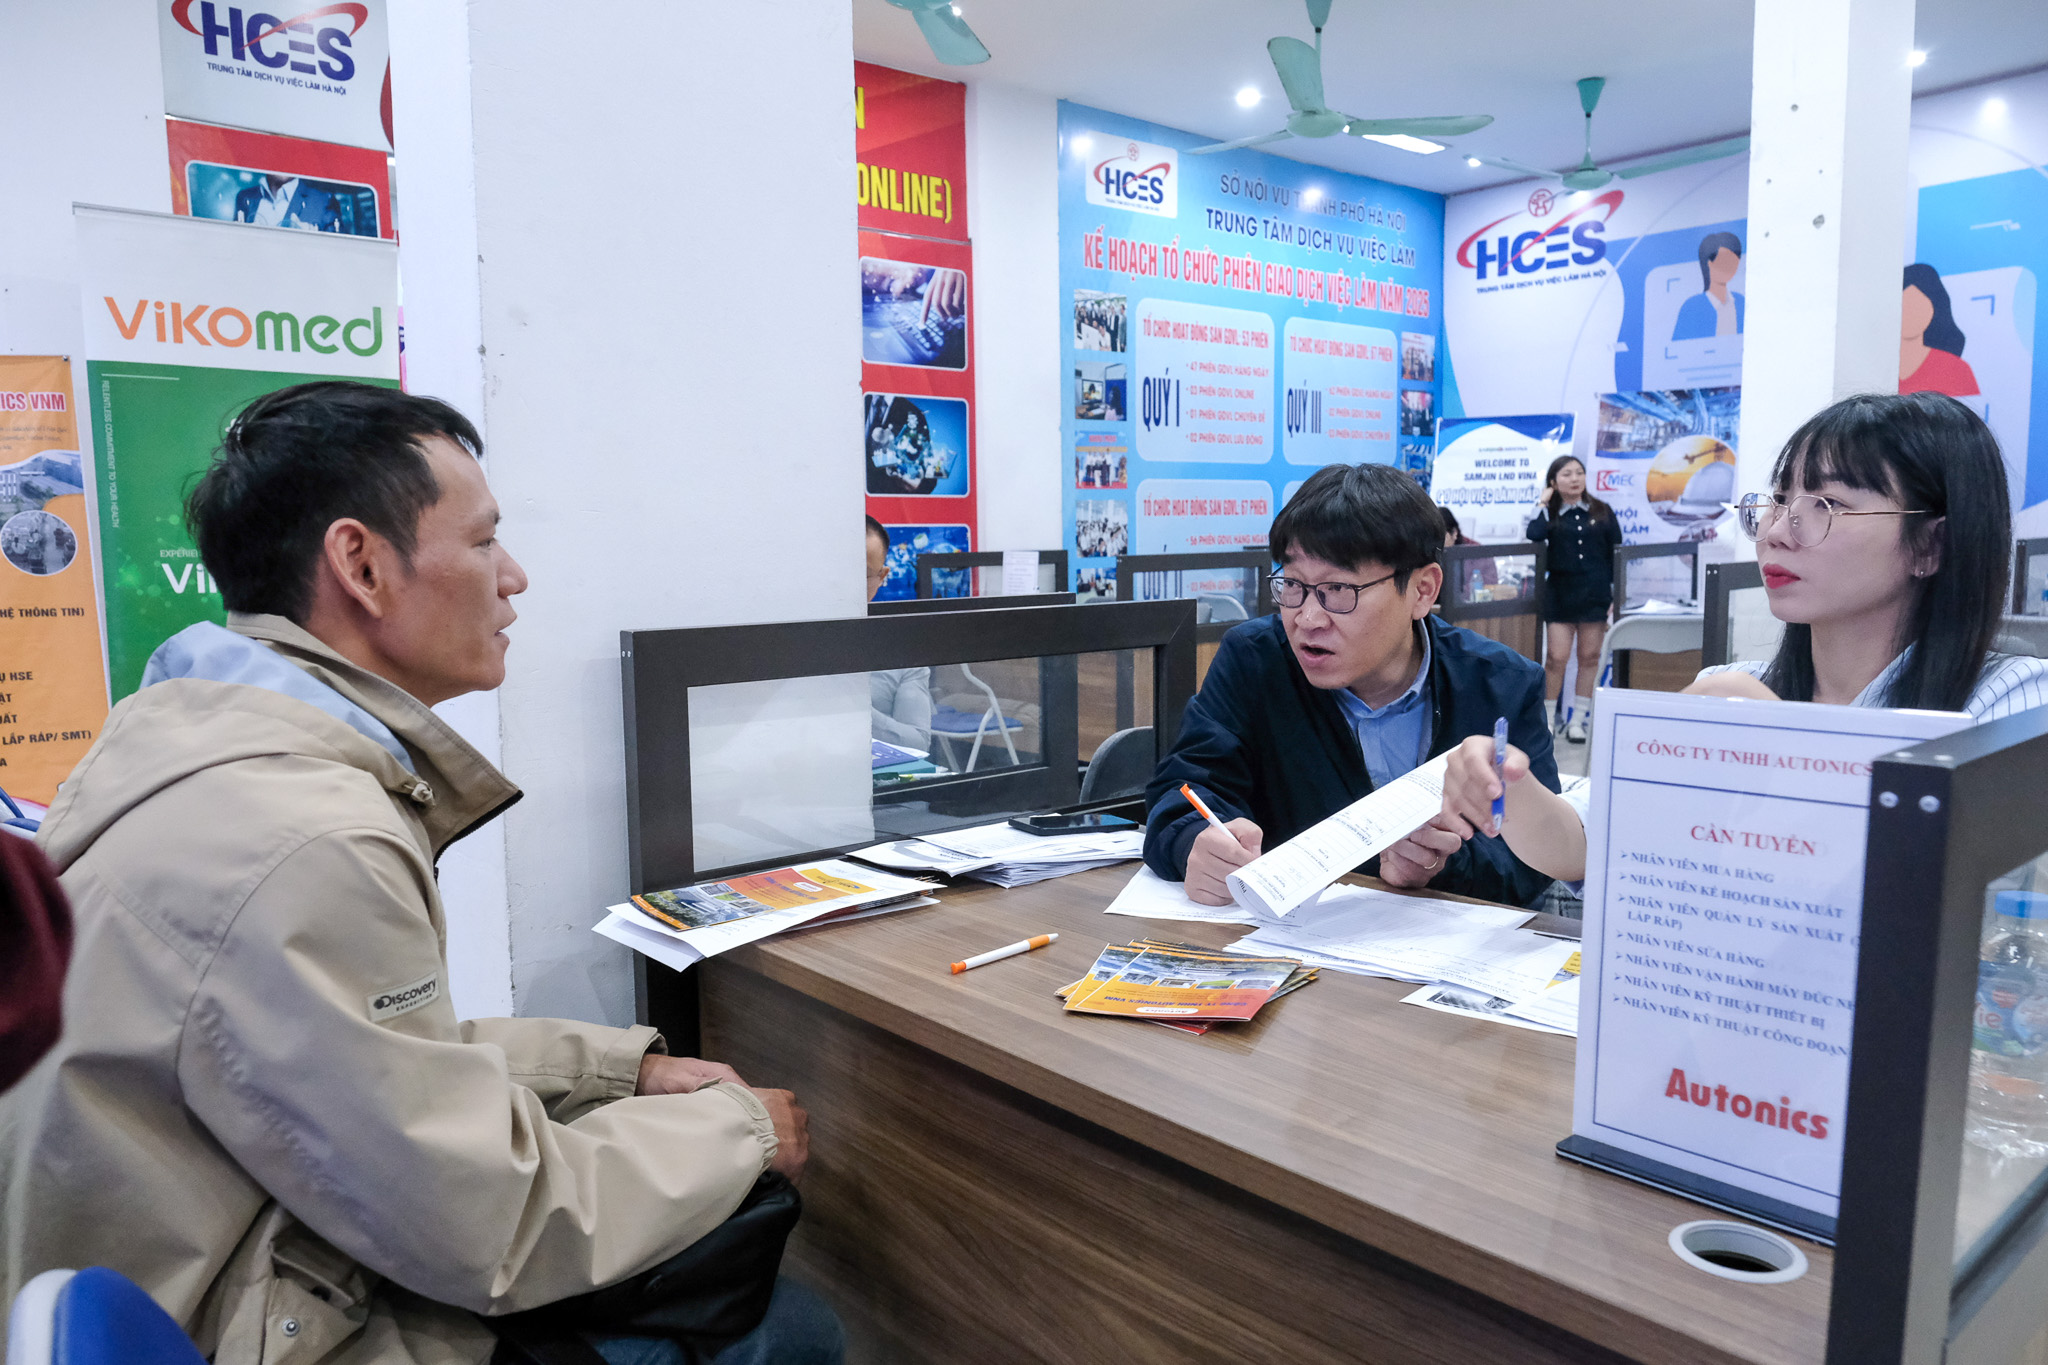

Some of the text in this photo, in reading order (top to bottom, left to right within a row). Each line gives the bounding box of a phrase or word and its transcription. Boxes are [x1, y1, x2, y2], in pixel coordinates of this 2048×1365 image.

[201, 1, 355, 81] HCES
[207, 62, 346, 96] TRUNG TÂM DỊCH VỤ VIỆC LÀM HÀ NỘI
[1105, 167, 1163, 204] HCES
[1221, 170, 1240, 195] SỞ
[1244, 178, 1267, 204] NỘI
[1272, 187, 1289, 208] VỤ
[1341, 197, 1365, 223] PHỐ
[1369, 204, 1384, 226] HÀ
[1388, 208, 1406, 234] NỘI
[1206, 208, 1415, 268] TRUNG TÂM DỊCH VỤ VIỆC LÀM
[1477, 220, 1606, 280] HCES
[1084, 225, 1430, 318] KẾ HOẠCH TỔ CHỨC PHIÊN GIAO DỊCH VIỆC LÀM NĂM 2025
[30, 393, 65, 411] VNM
[102, 380, 112, 423] RELENTLESS
[1143, 367, 1180, 432] QUÝ I
[1287, 379, 1321, 438] QUÝ III
[105, 424, 115, 470] COMMITMENT
[1475, 458, 1530, 468] WELCOME TO
[1464, 472, 1537, 481] SAMJIN LND VINA
[111, 502, 119, 528] HEALTH
[1623, 522, 1649, 534] LÀM
[18, 607, 57, 617] THÔNG
[61, 607, 85, 617] TIN)
[29, 731, 58, 743] RÁP/
[61, 730, 91, 741] SMT)
[1637, 739, 1872, 777] CÔNG TY TNHH AUTONICS
[1691, 823, 1816, 856] CẦN TUYỂN
[1631, 852, 1775, 883] NHÂN VIÊN MUA HÀNG
[1630, 872, 1844, 919] NHÂN VIÊN KẾ HOẠCH SẢN XUẤT
[1628, 894, 1663, 909] NHÂN
[1669, 901, 1698, 916] VIÊN
[1704, 907, 1741, 924] QUẢN
[1747, 915, 1764, 929] LÝ
[1771, 918, 1799, 936] SẢN
[1804, 924, 1844, 944] XUẤT
[1628, 910, 1683, 931] LẮP RÁP)
[1627, 931, 1660, 947] NHÂN
[1664, 939, 1693, 954] VIÊN
[1726, 951, 1765, 969] HÀNG
[1625, 953, 1833, 1006] NHÂN VIÊN VẬN HÀNH MÁY ĐÚC
[1624, 974, 1825, 1031] NHÂN VIÊN KỸ THUẬT THIẾT BỊ
[1623, 995, 1848, 1057] NHÂN VIÊN KỸ THUẬT CÔNG ĐOẠN
[1665, 1068, 1829, 1139] Autonics
